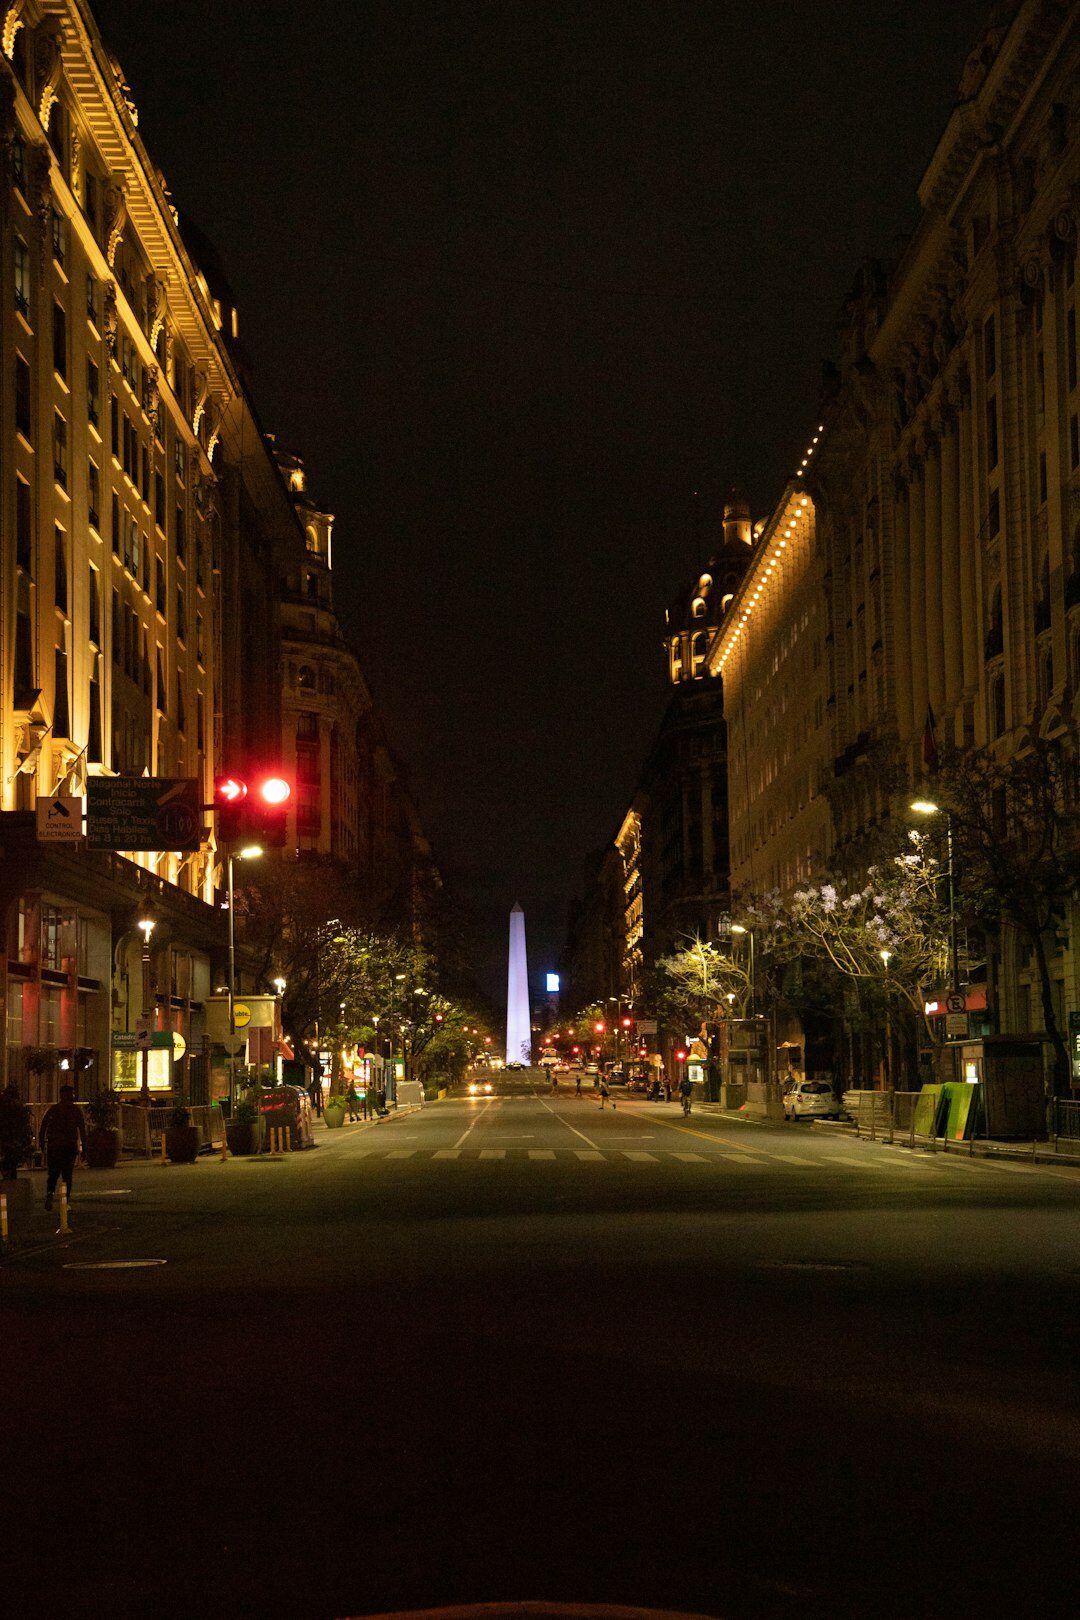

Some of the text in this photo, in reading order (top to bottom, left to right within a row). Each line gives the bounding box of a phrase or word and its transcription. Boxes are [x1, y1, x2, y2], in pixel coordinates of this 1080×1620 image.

[88, 780, 131, 789] Diagonal
[110, 789, 138, 797] Inicio
[88, 816, 118, 824] Buses
[131, 816, 159, 825] Taxis
[88, 834, 101, 842] de
[104, 834, 111, 842] 8
[124, 834, 138, 843] 20
